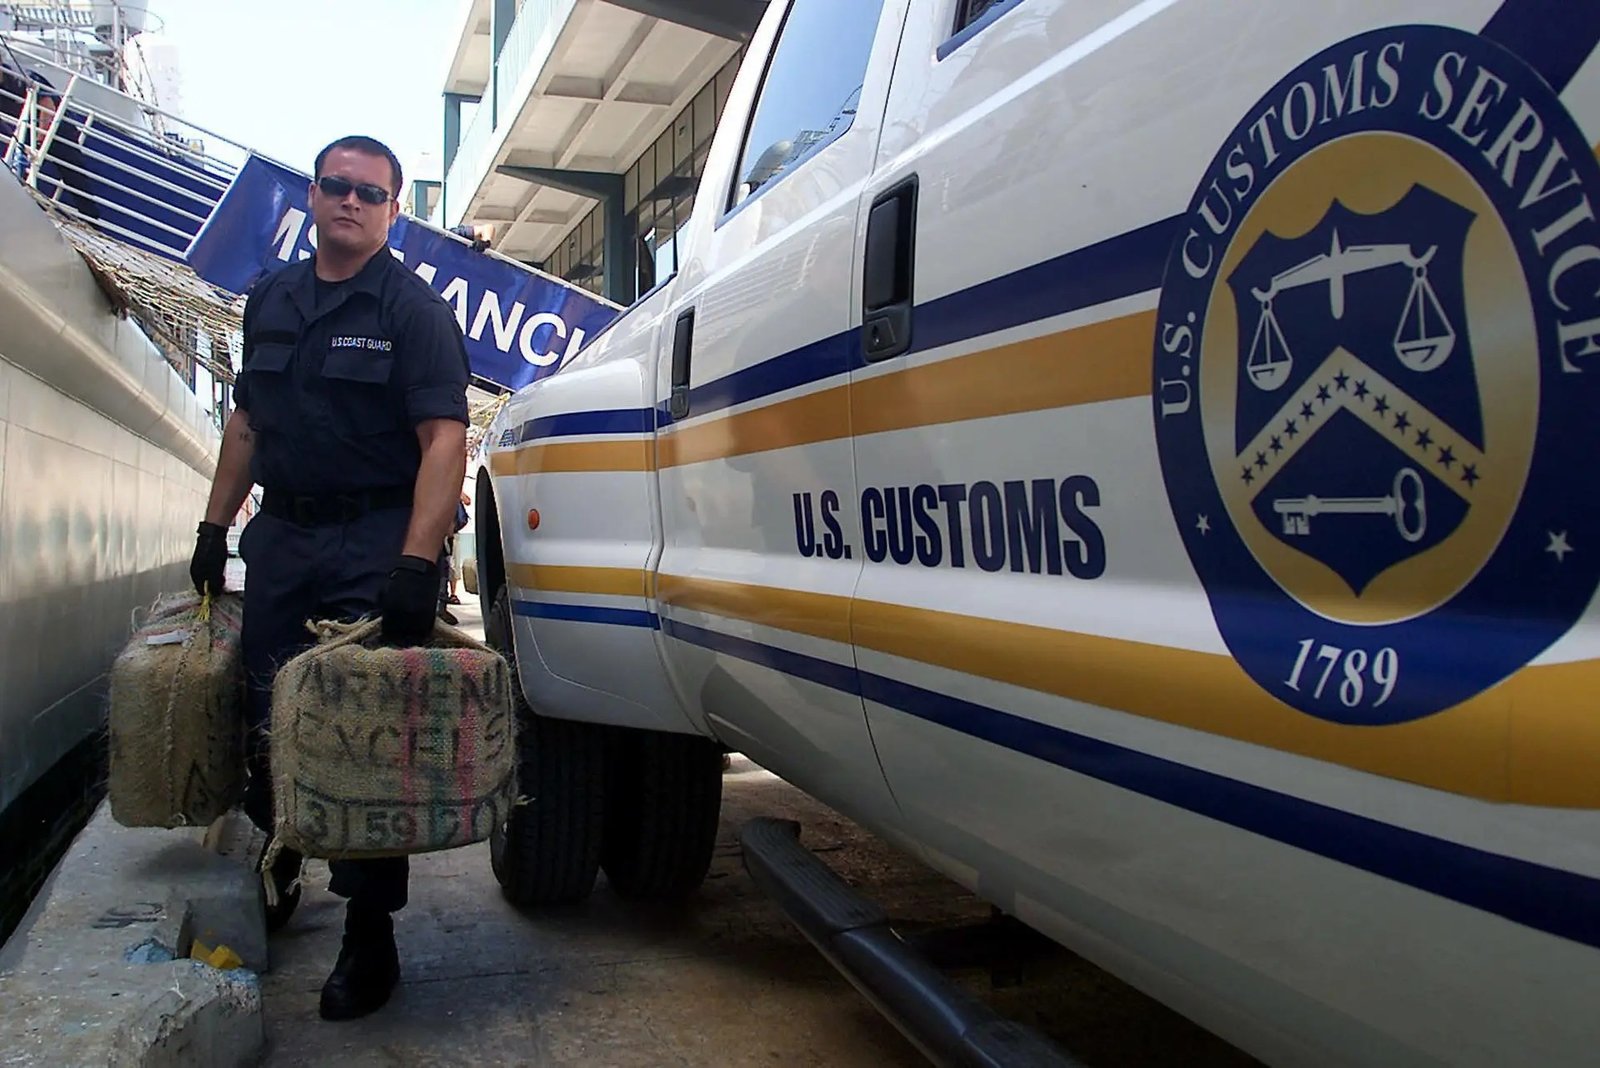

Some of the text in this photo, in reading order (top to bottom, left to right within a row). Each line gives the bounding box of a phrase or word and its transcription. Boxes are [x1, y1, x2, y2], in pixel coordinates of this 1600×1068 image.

[1160, 42, 1600, 418] U.S. CUSTOMS SERVICE
[343, 336, 367, 348] COAST
[367, 338, 392, 351] GUARD
[793, 475, 1107, 580] U.S. CUSTOMS
[1284, 638, 1399, 707] 1789
